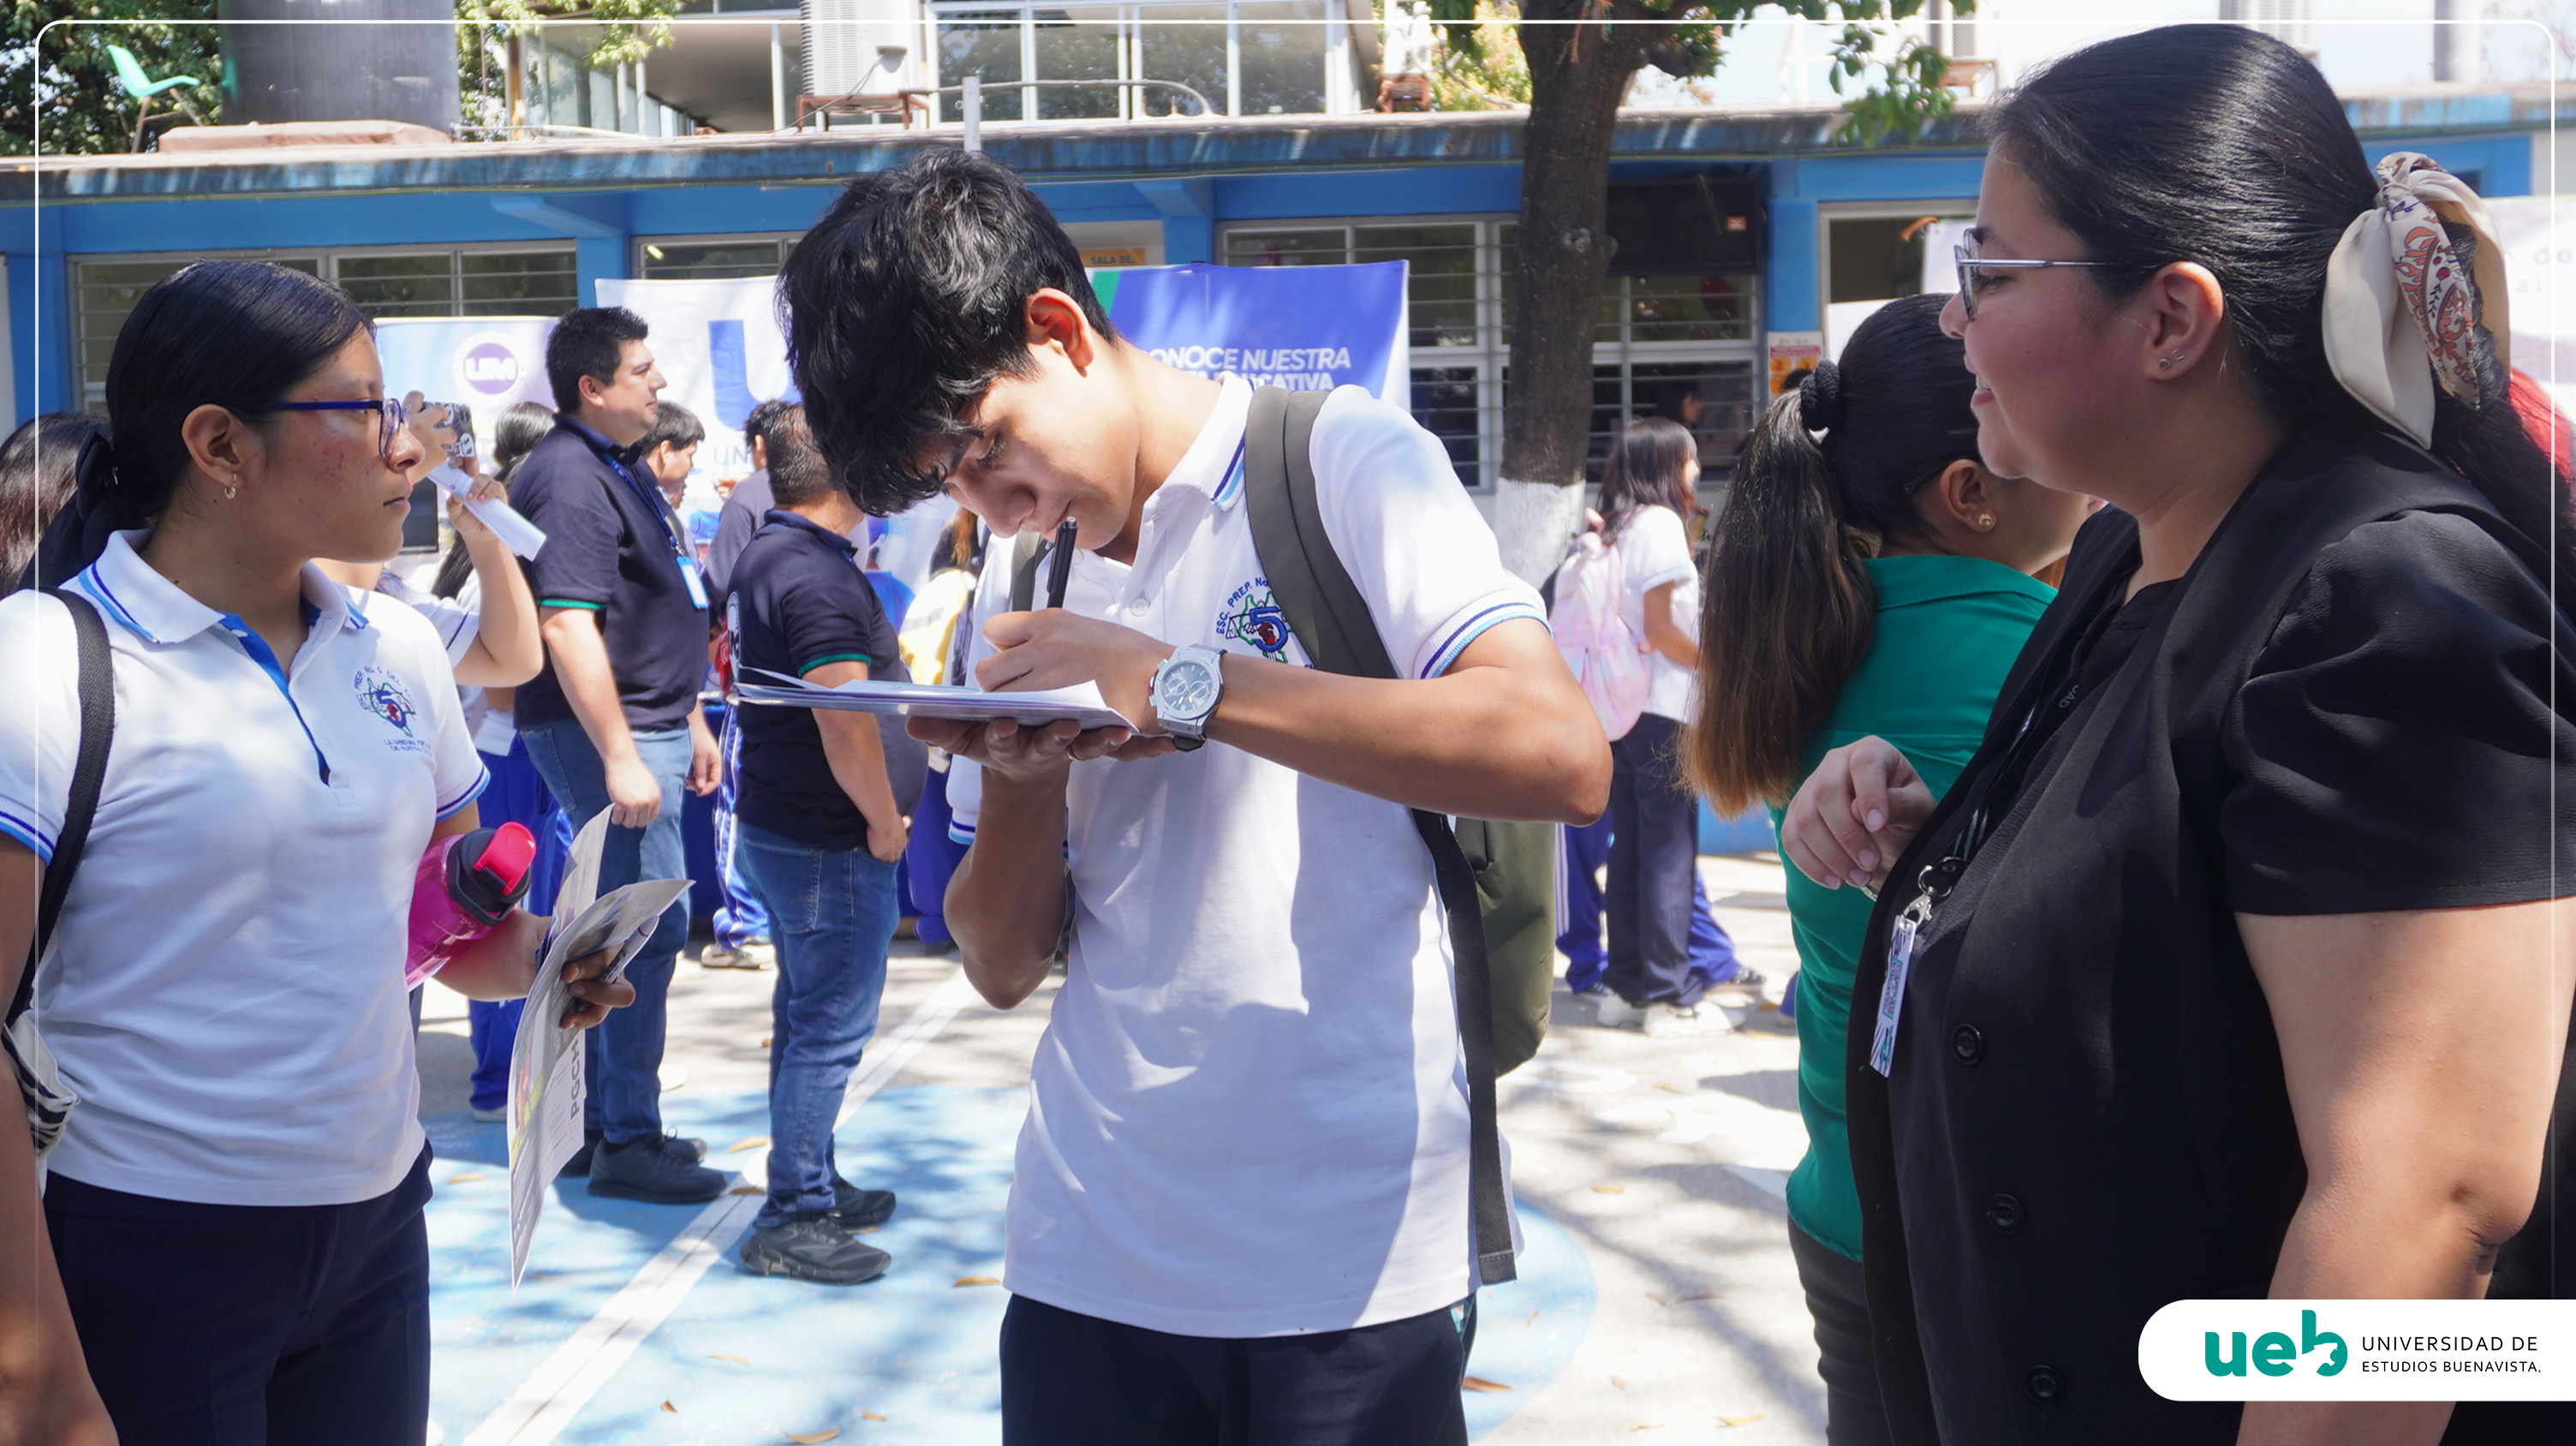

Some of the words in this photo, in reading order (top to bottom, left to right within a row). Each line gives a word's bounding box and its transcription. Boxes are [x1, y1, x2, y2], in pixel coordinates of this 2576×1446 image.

[1090, 255, 1117, 265] SALA
[1118, 254, 1133, 264] DE
[1142, 344, 1238, 371] ONOCE
[1243, 347, 1351, 371] NUESTRA
[1227, 581, 1253, 607] PREP.
[1249, 606, 1289, 652] 5
